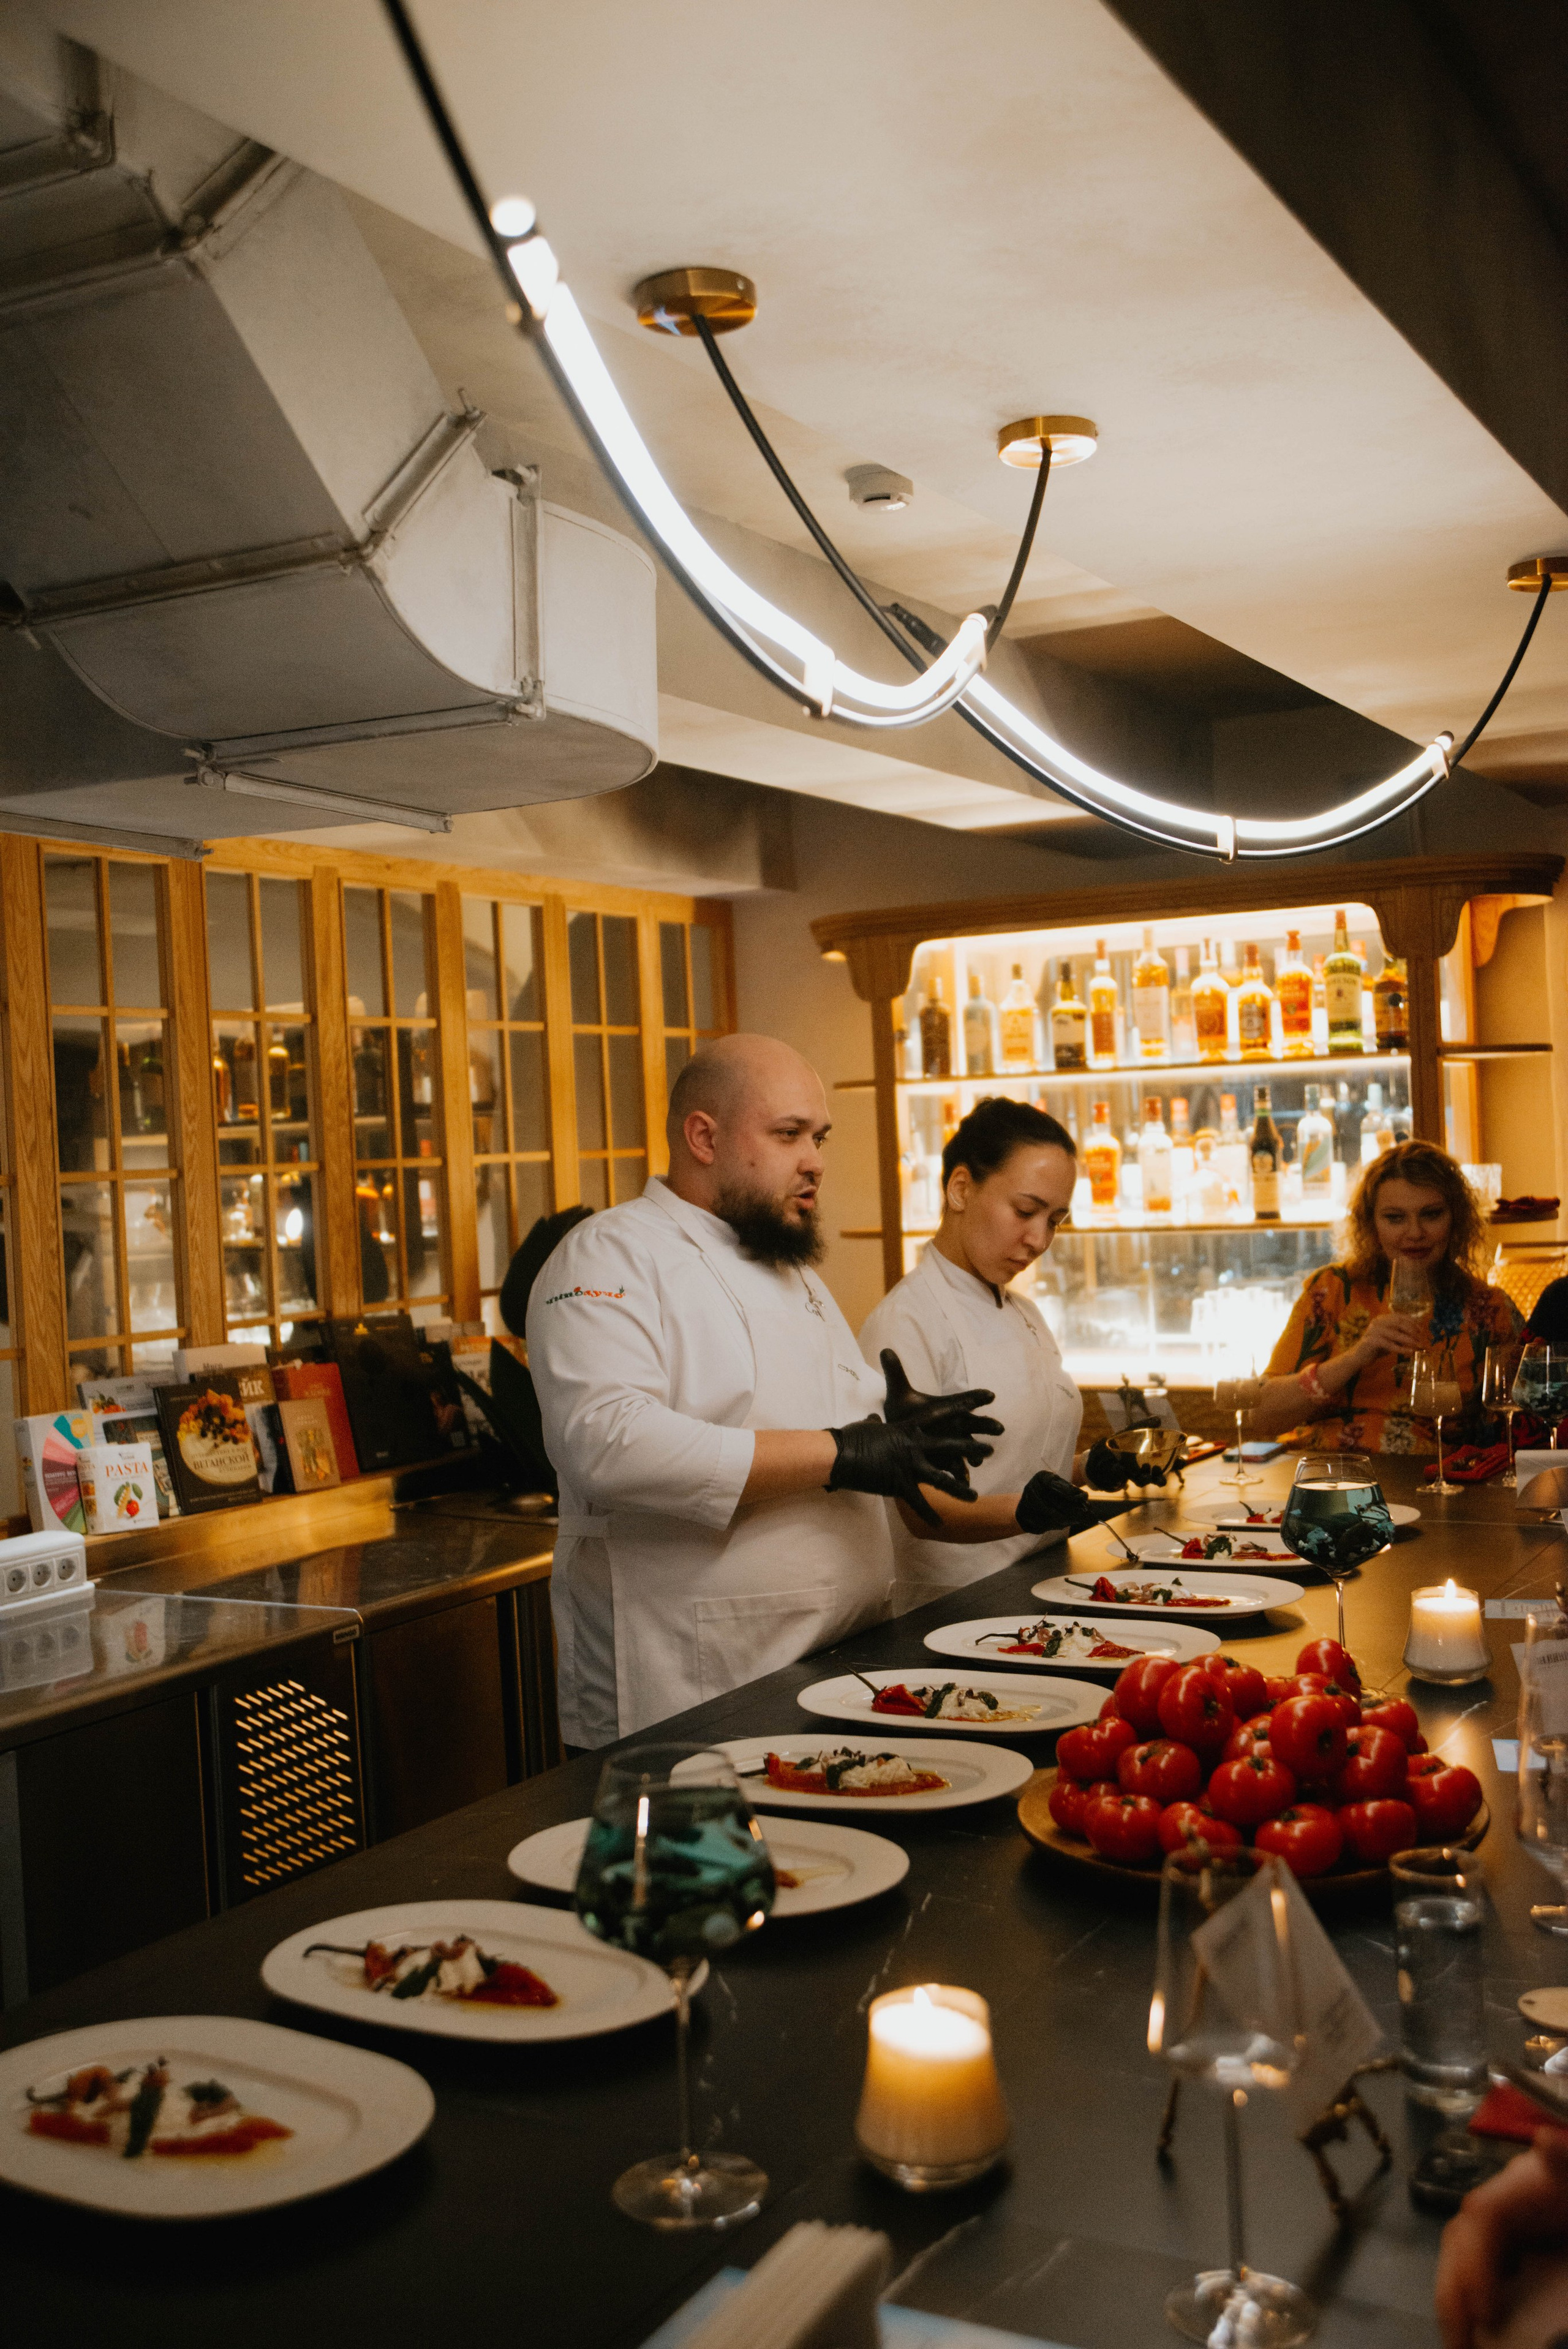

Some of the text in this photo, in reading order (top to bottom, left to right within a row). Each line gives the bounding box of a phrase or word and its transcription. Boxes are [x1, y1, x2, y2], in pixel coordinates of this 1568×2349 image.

[239, 1378, 265, 1397] ЙК
[105, 1461, 148, 1477] PASTA
[193, 1451, 250, 1469] ВЕГАНСКОЙ
